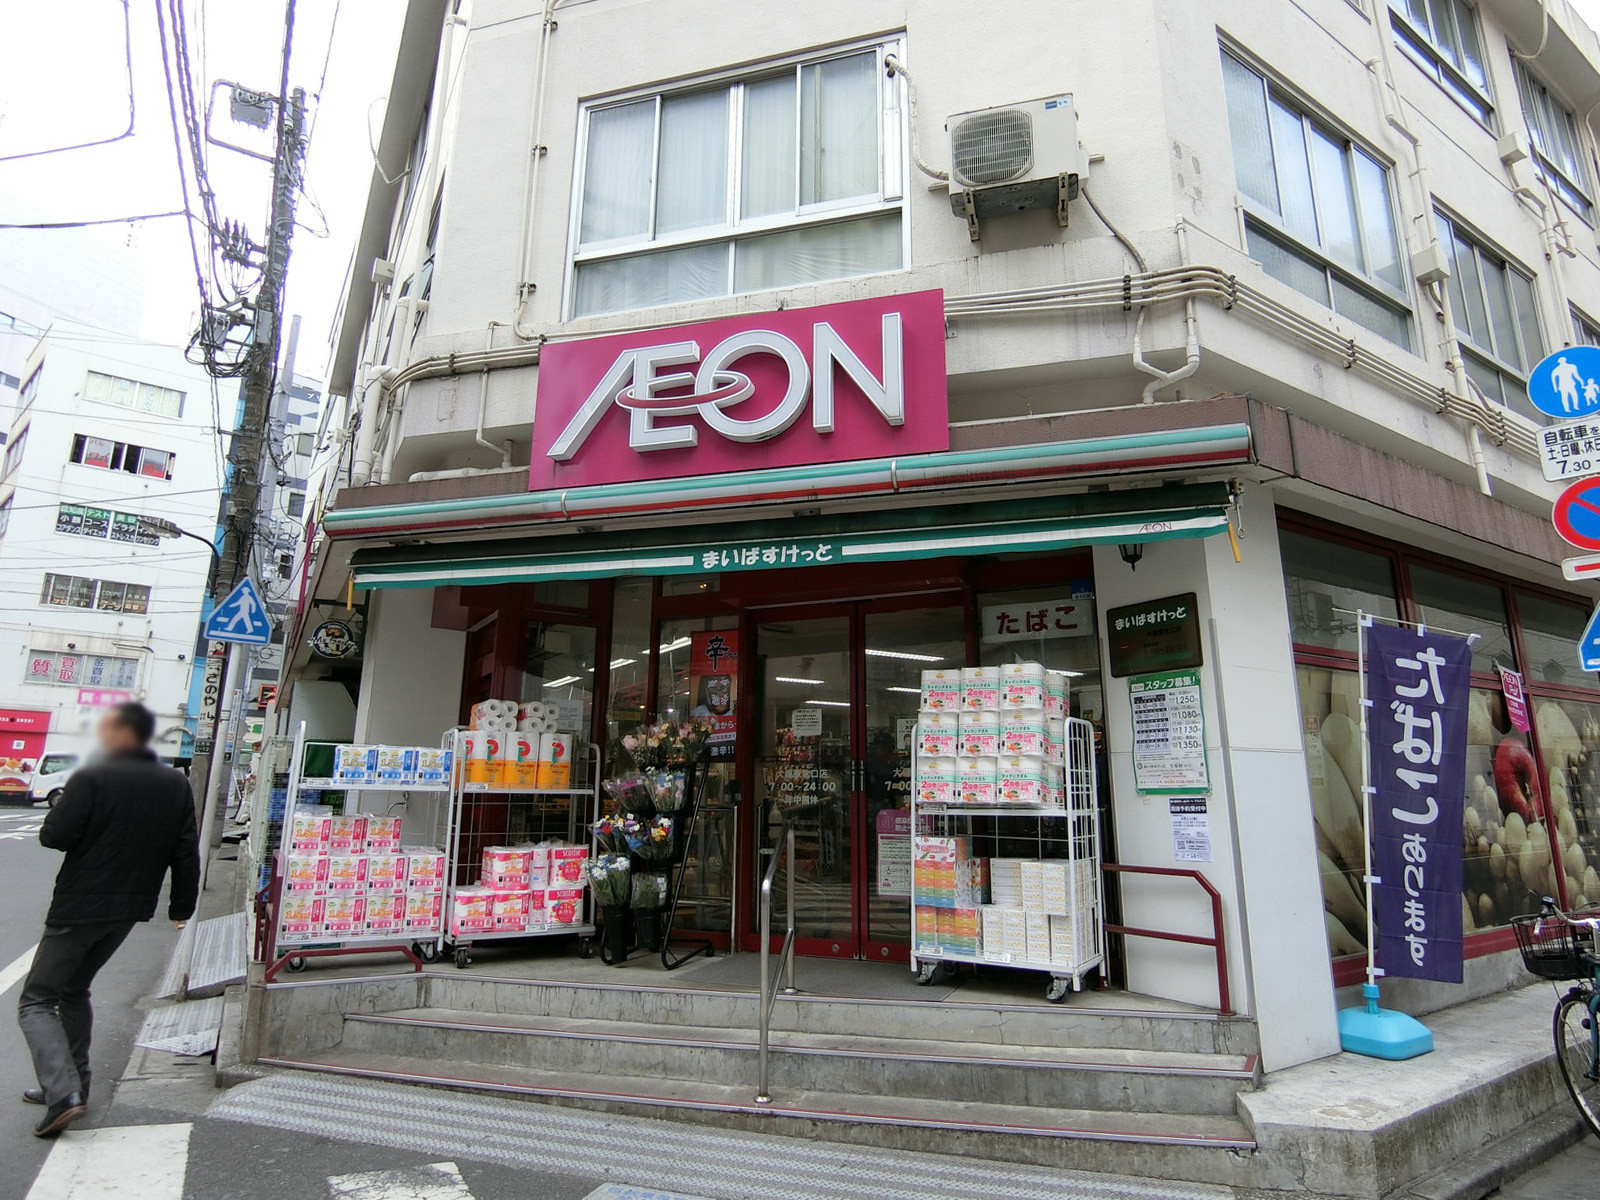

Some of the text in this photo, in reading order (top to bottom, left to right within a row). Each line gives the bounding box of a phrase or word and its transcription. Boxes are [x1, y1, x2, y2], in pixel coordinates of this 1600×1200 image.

[1544, 425, 1600, 445] 自転車を
[702, 543, 833, 569] まいばすけっと
[996, 605, 1078, 635] たばこ
[1115, 606, 1187, 631] まいばすけっと
[706, 635, 730, 672] 辛
[31, 659, 51, 676] 質
